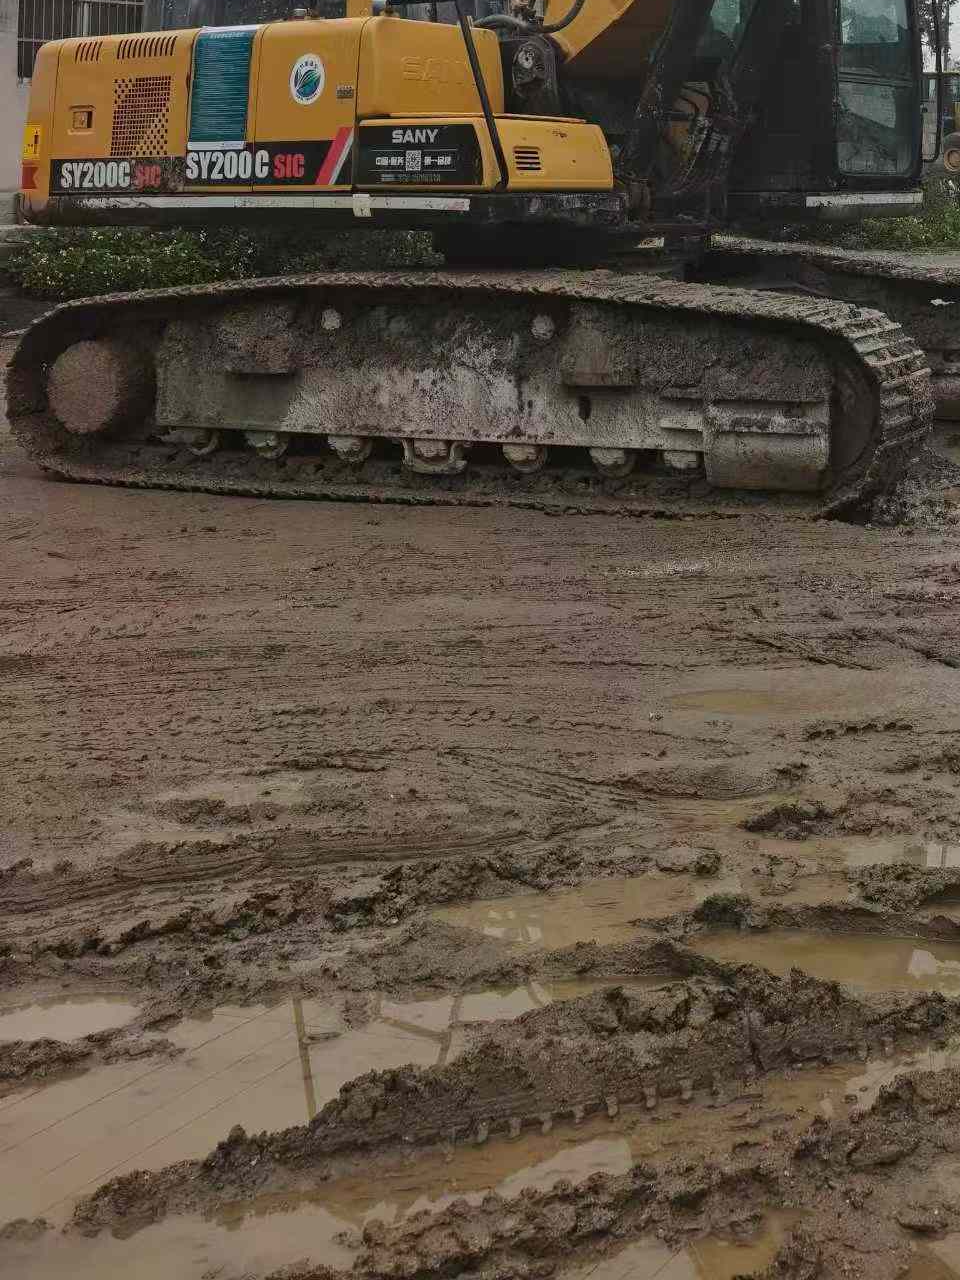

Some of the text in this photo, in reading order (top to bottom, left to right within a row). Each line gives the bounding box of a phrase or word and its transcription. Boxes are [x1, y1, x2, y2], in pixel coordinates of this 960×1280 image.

[391, 128, 439, 144] SANY
[61, 161, 131, 188] SY200C
[186, 150, 269, 180] SY200C
